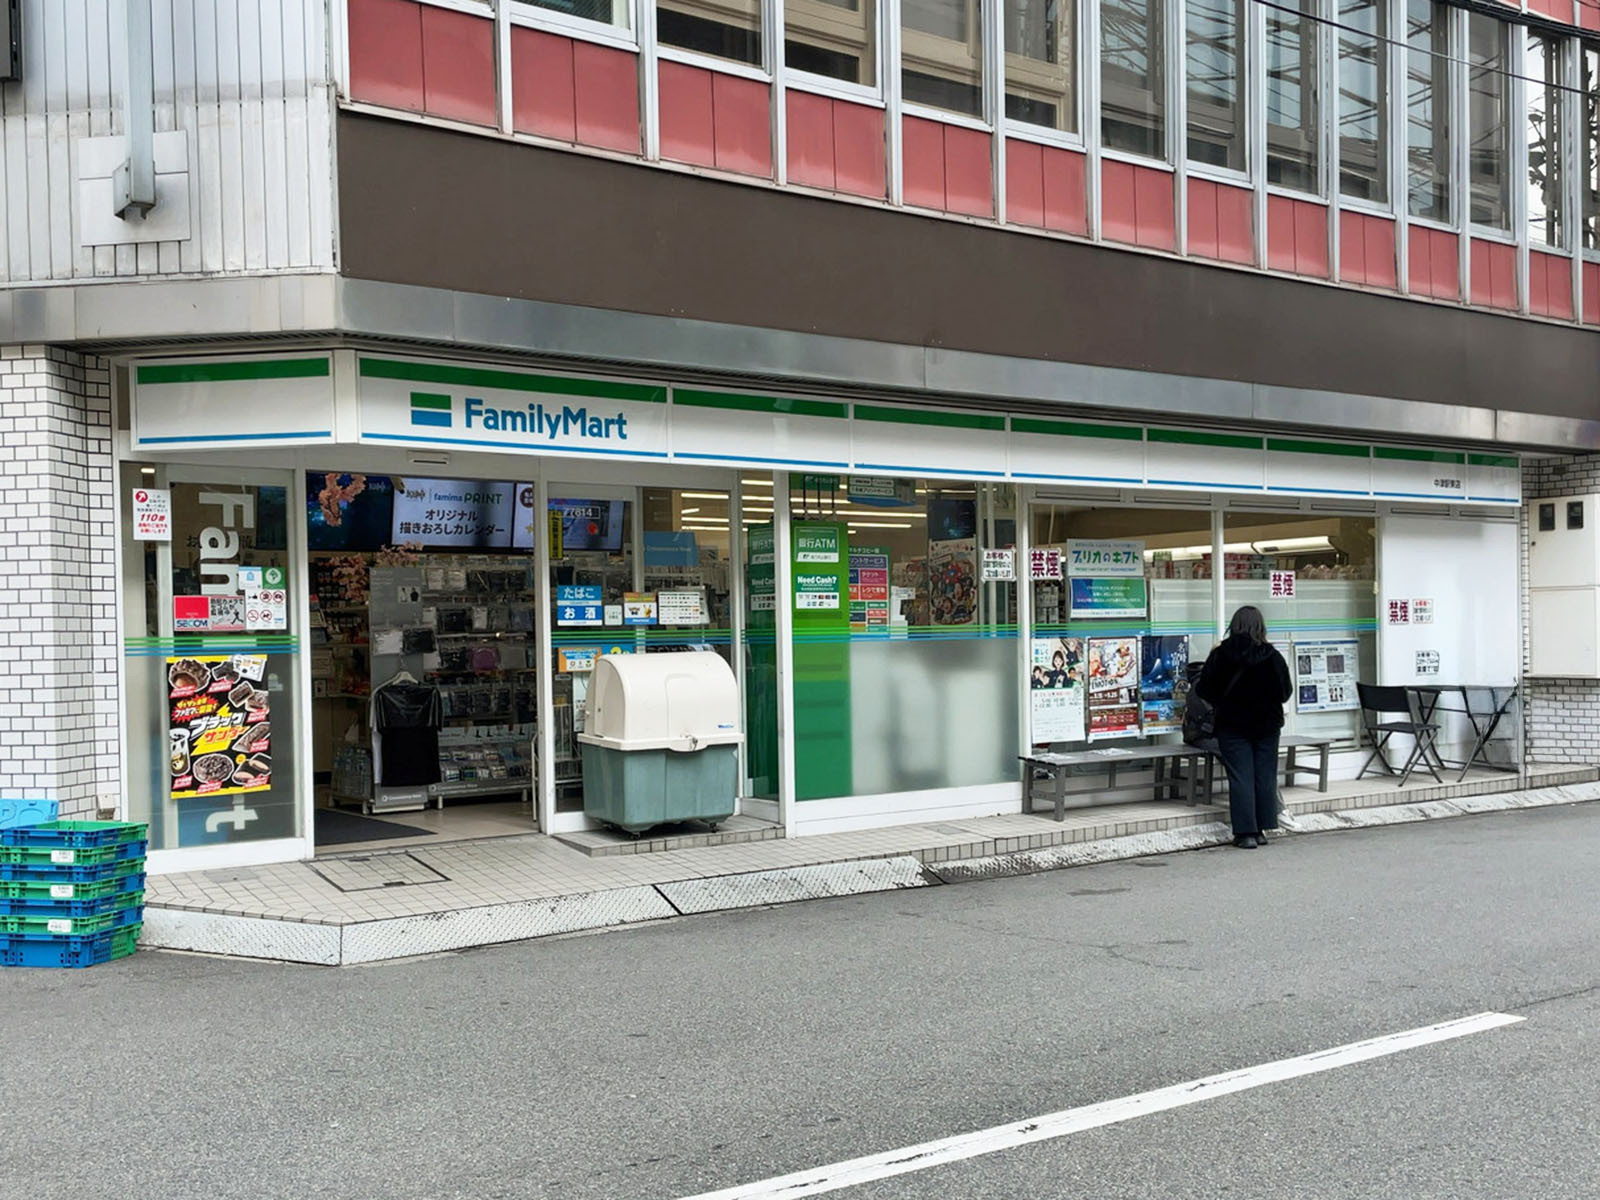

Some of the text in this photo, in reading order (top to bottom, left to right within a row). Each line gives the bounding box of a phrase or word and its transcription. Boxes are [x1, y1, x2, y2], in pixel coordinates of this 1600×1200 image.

[465, 397, 628, 440] FamilyMart
[463, 492, 502, 505] PRINT
[425, 509, 478, 521] オリジナル
[399, 521, 505, 536] 描きおろしカレンダー
[1031, 550, 1059, 577] 禁煙
[797, 576, 837, 585] Need Cash?
[1272, 574, 1293, 596] 禁煙
[564, 587, 595, 599] たばこ
[564, 607, 596, 619] お酒
[1389, 601, 1409, 622] 禁煙
[176, 619, 208, 628] SECOM
[188, 711, 247, 741] ブラック
[204, 725, 251, 744] サンダー
